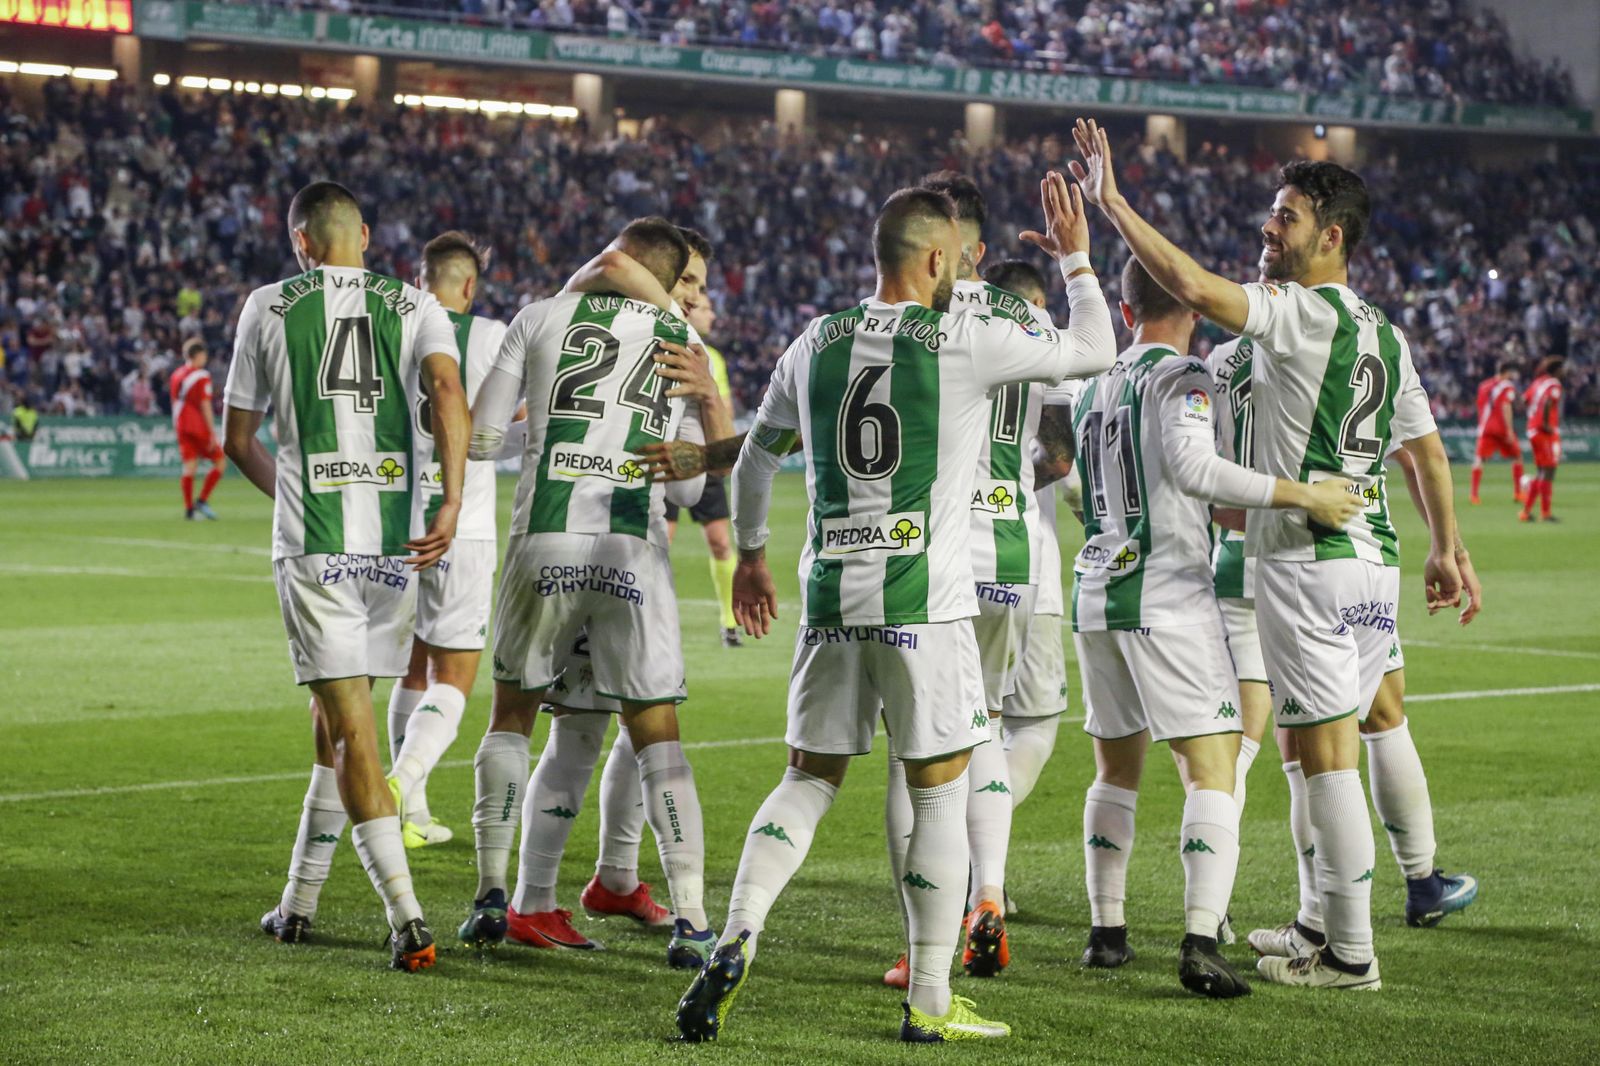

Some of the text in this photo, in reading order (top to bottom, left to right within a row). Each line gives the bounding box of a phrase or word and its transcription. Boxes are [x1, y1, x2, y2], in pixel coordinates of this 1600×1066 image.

[990, 70, 1100, 102] SASEGUR
[269, 276, 324, 317] ALEX
[812, 317, 949, 352] EDU RAMOS
[317, 313, 385, 416] 4
[549, 321, 675, 440] 24
[837, 362, 902, 482] 6
[1337, 352, 1388, 462] 2
[1076, 405, 1142, 519] 11
[540, 564, 636, 586] CORHYUND
[562, 579, 644, 606] HYUNDAI
[825, 627, 918, 650] HYUNDAI
[663, 791, 684, 843] CORDOBA
